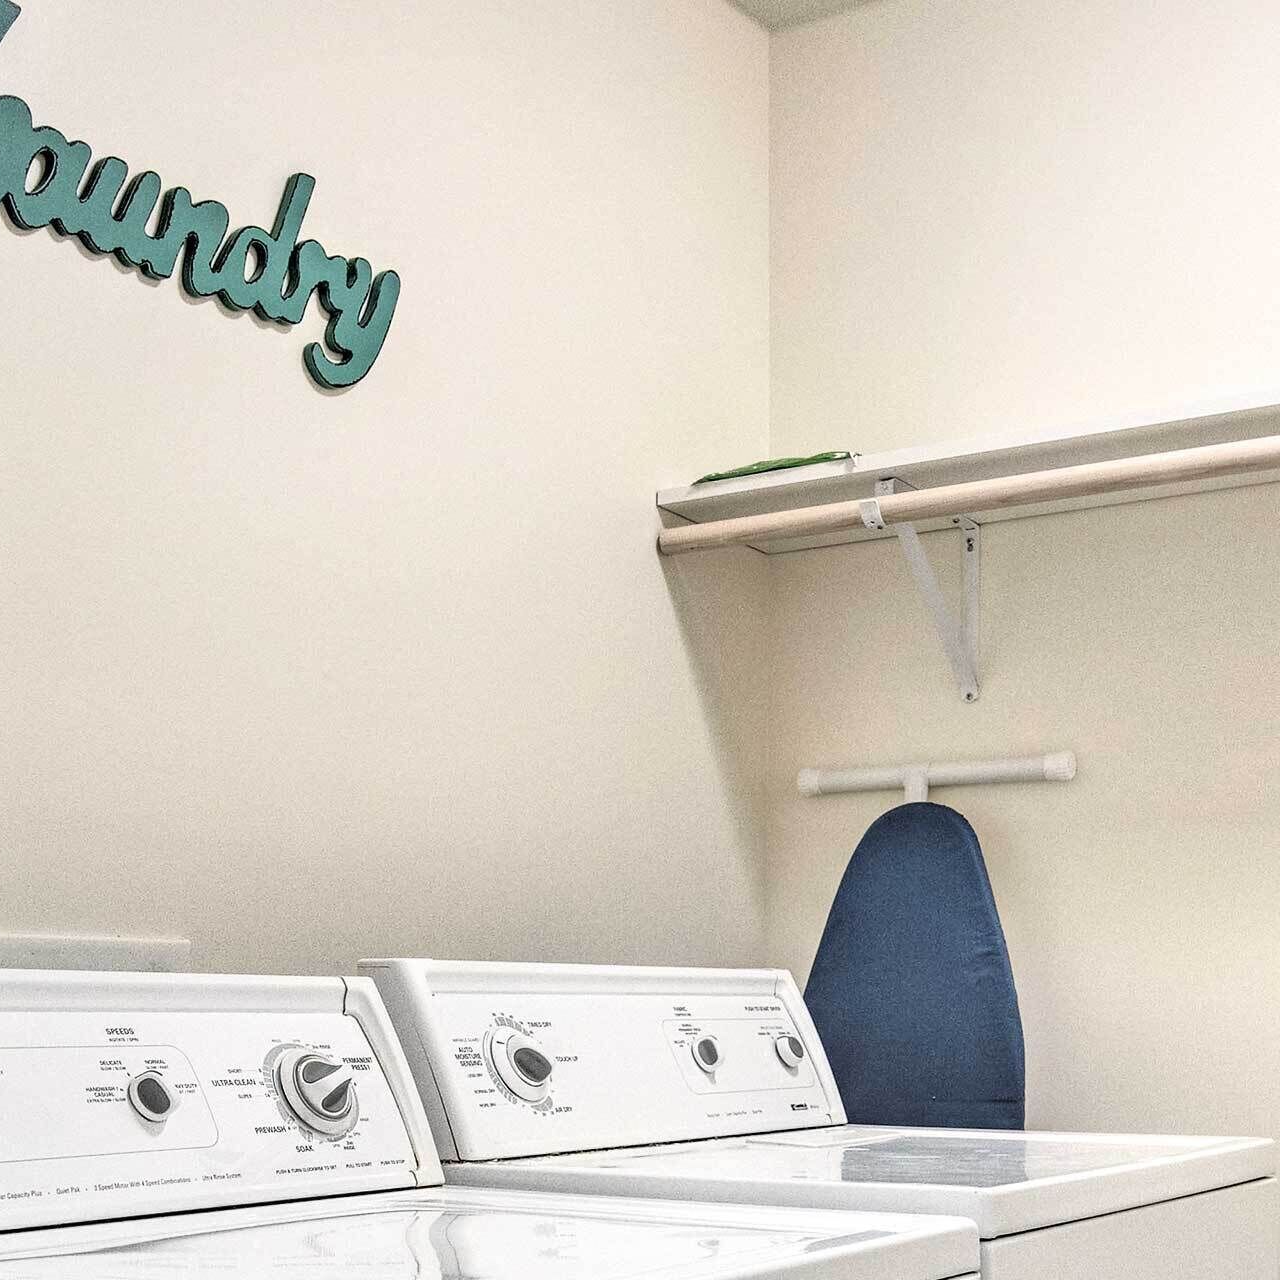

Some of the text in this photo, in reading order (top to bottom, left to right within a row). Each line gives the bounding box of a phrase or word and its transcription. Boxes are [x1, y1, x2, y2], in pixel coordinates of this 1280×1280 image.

[105, 1027, 135, 1036] SPEEDS
[341, 1057, 373, 1065] PERMANENT
[211, 1079, 234, 1087] ULTRA
[234, 1078, 257, 1087] CLEAN
[254, 1125, 288, 1134] PREWASH
[295, 1145, 315, 1153] SOAK
[6, 1191, 31, 1201] Capacity
[30, 1189, 43, 1198] Plus
[56, 1188, 70, 1196] Quiet
[98, 1183, 114, 1192] Speed
[145, 1179, 161, 1188] Speed
